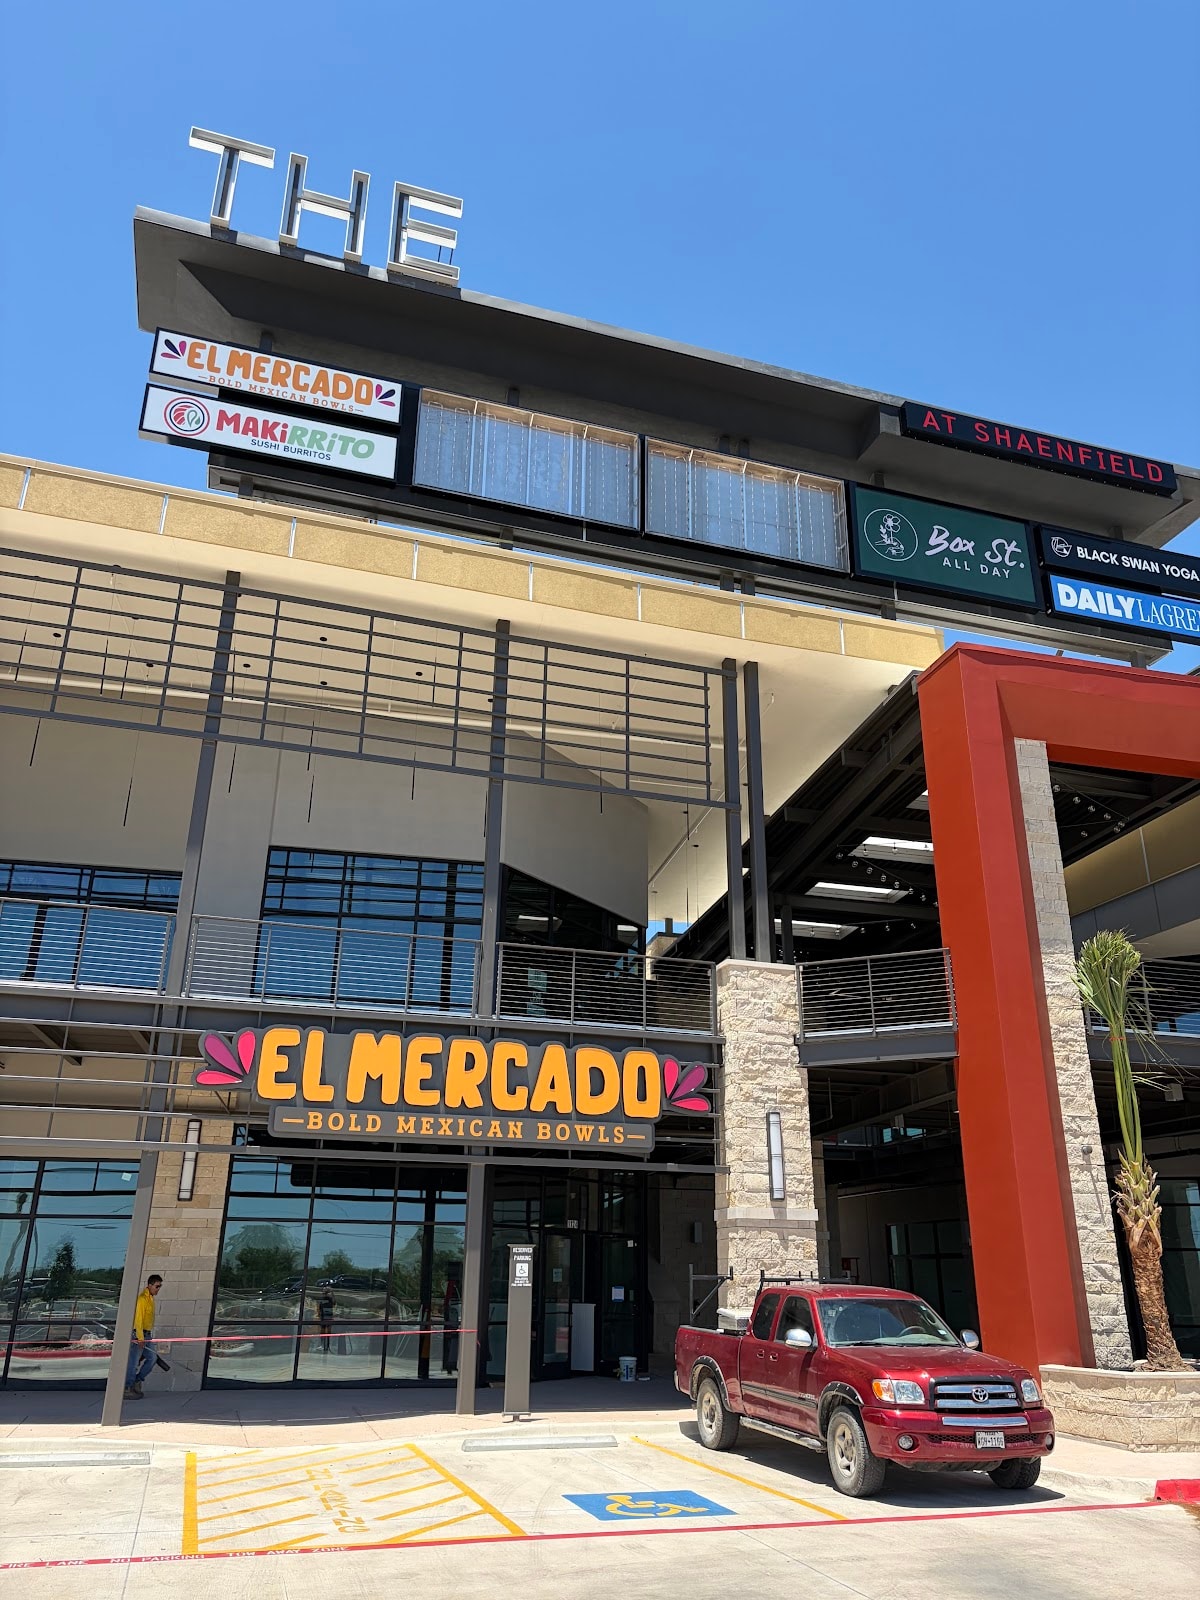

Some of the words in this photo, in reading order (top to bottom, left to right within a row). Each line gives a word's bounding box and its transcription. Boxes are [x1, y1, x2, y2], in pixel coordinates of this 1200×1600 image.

[189, 126, 463, 283] THE
[187, 341, 221, 373] EL
[226, 350, 374, 406] MERCADO
[209, 375, 242, 389] BOLD
[249, 384, 307, 402] MEXICAN
[313, 397, 354, 413] BOWLS
[250, 438, 280, 451] SUSHI
[283, 445, 331, 461] BURRITOS
[923, 410, 956, 434] AT
[974, 422, 1163, 483] SHAENFIELD
[925, 525, 976, 556] Box
[985, 539, 1025, 569] St.
[943, 556, 971, 571] ALL
[980, 563, 1011, 579] DAY
[1076, 546, 1119, 566] BLACK
[1121, 555, 1160, 574] SWAN
[1162, 563, 1200, 582] YOGA
[1057, 583, 1136, 620] DAILY
[1134, 599, 1200, 632] LAGRE
[257, 1028, 335, 1102] EL
[346, 1032, 661, 1118] MERCADO
[306, 1111, 382, 1132] BOLD
[396, 1115, 523, 1139] MEXICAN
[537, 1122, 625, 1144] BOWLS
